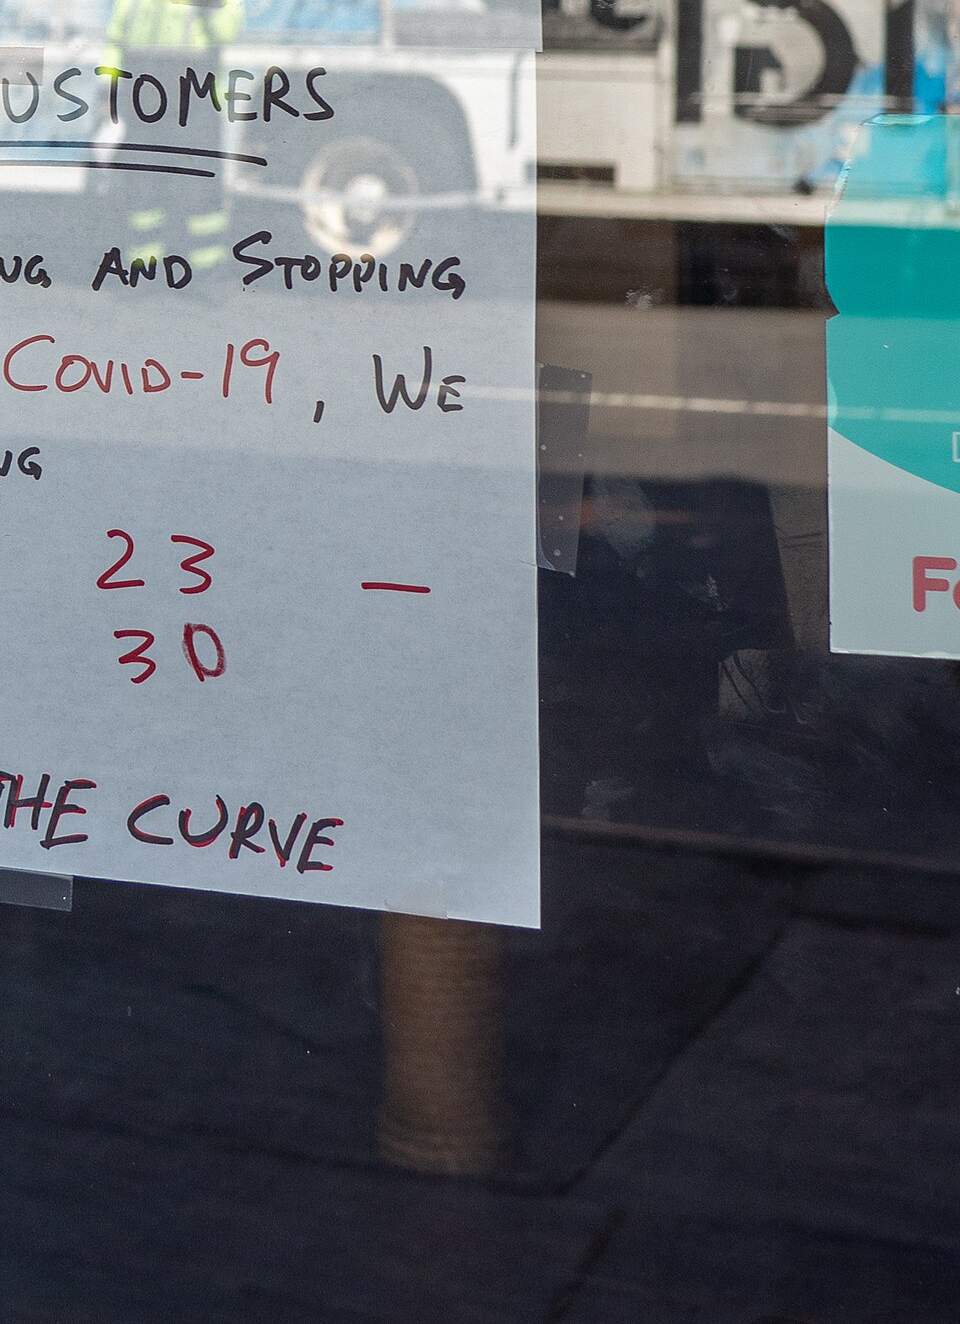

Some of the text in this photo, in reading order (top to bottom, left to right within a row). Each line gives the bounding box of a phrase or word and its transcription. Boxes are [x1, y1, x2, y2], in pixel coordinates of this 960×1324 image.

[91, 246, 194, 292] AND
[233, 230, 467, 301] STOPPING
[372, 345, 467, 415] WE
[95, 528, 217, 596] 23
[113, 622, 228, 685] 30
[126, 793, 345, 875] CURVE
